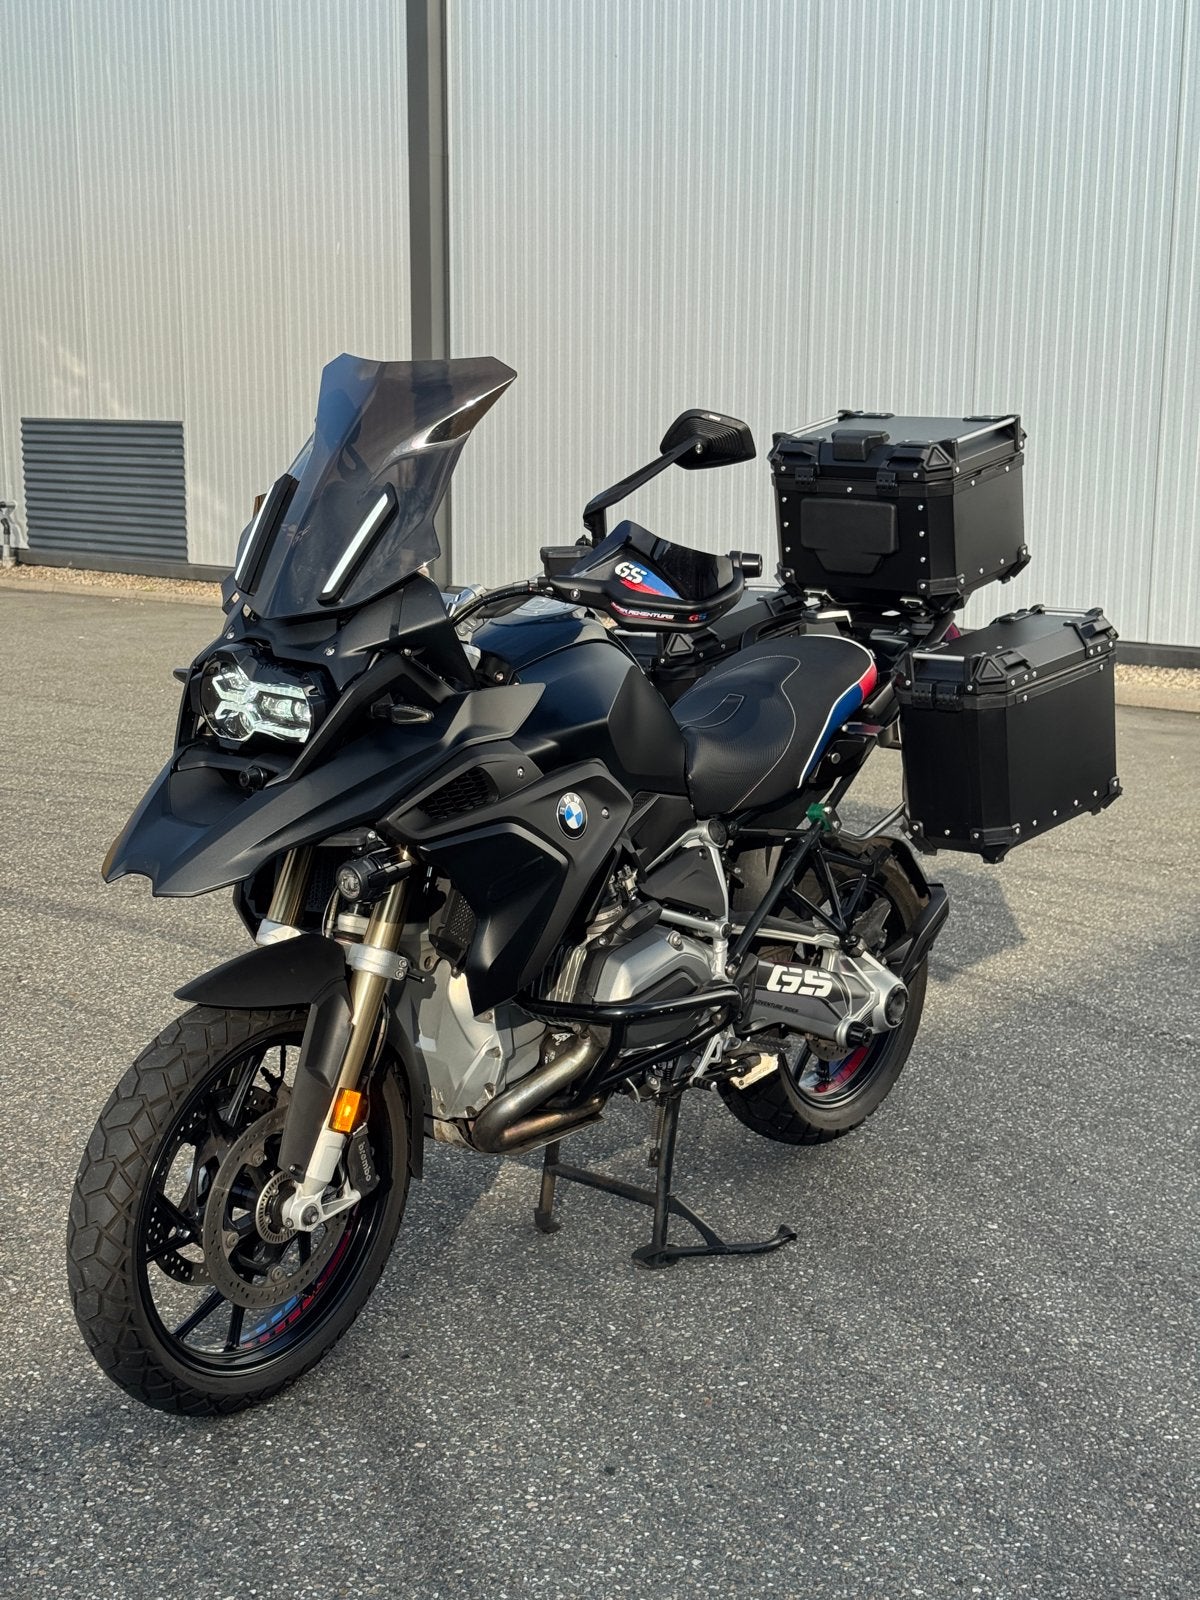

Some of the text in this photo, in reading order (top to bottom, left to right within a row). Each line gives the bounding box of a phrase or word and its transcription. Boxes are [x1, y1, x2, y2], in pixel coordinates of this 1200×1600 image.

[614, 562, 648, 584] GS
[628, 608, 676, 620] ADVENTURE
[766, 965, 833, 998] GS
[358, 1141, 372, 1182] brembo
